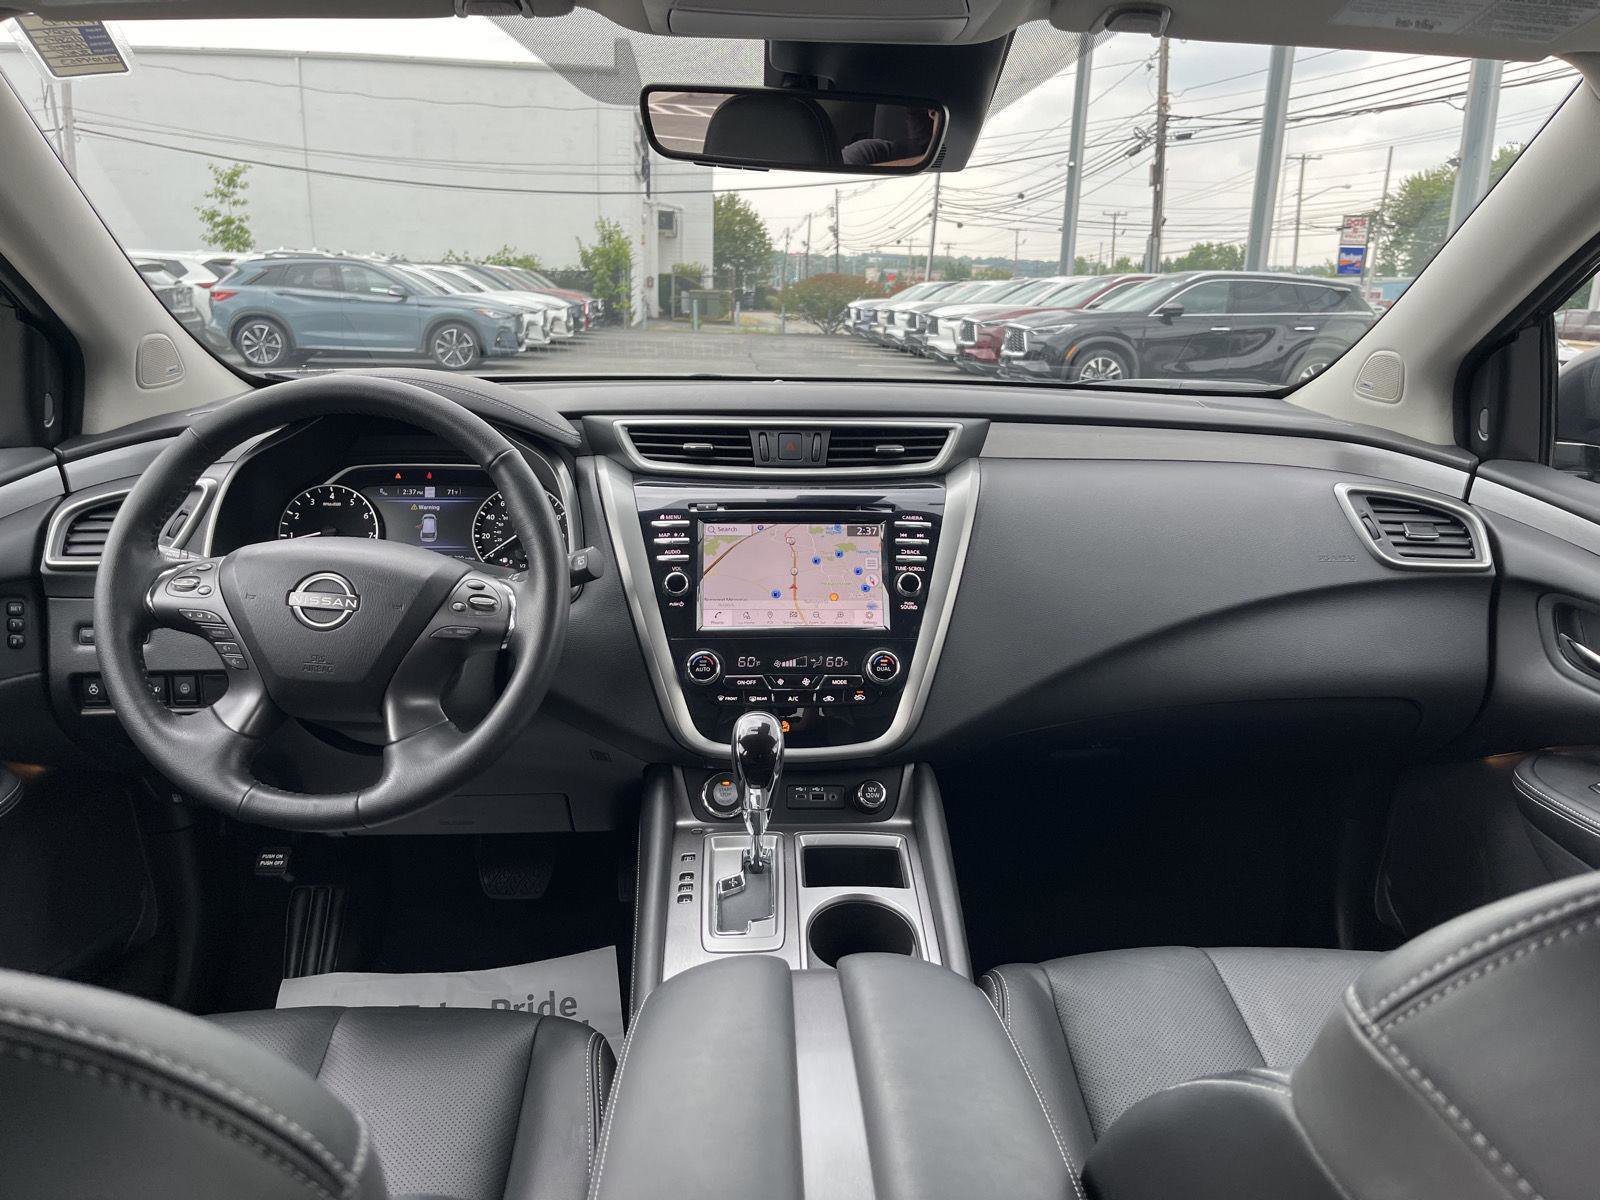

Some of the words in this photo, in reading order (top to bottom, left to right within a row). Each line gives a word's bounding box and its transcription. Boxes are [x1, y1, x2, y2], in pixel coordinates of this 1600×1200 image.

[329, 492, 335, 500] 4
[310, 498, 315, 506] 3
[349, 498, 355, 506] 5
[294, 512, 300, 520] 2
[363, 512, 369, 520] 6
[856, 526, 878, 536] 2:37
[290, 594, 358, 609] NISSAN
